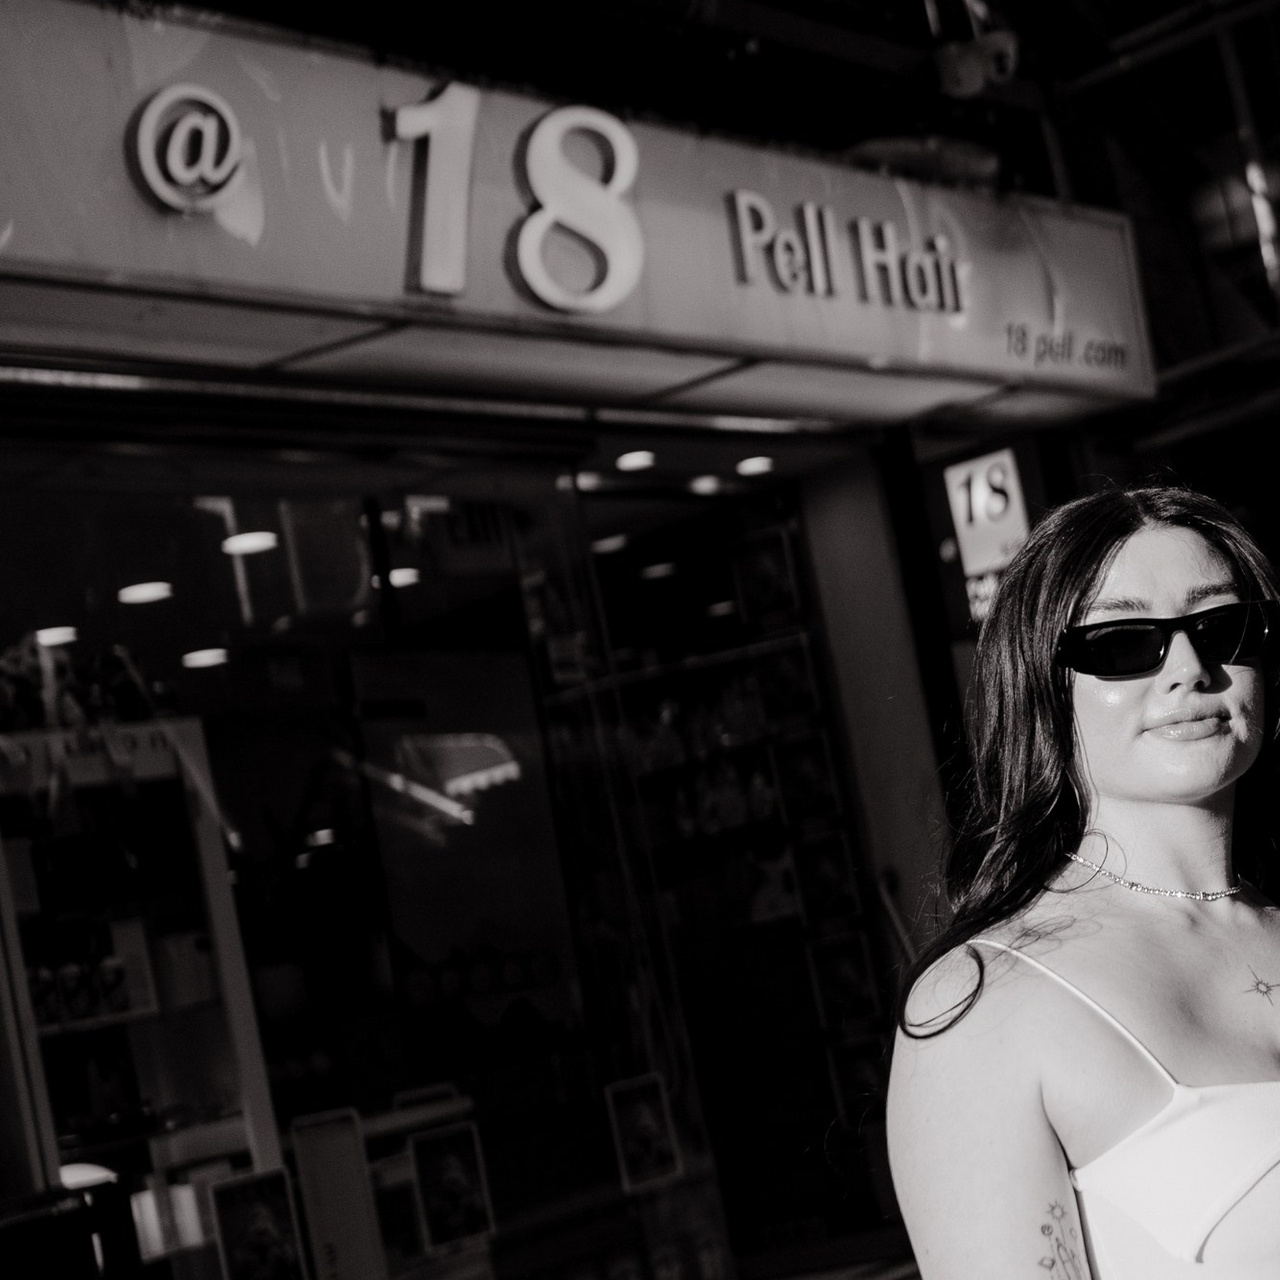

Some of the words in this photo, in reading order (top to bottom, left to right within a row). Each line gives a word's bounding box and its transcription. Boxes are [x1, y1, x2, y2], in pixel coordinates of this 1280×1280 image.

[130, 82, 244, 216] @
[390, 78, 645, 314] 18
[725, 189, 835, 299] Pell
[848, 217, 969, 316] Hair
